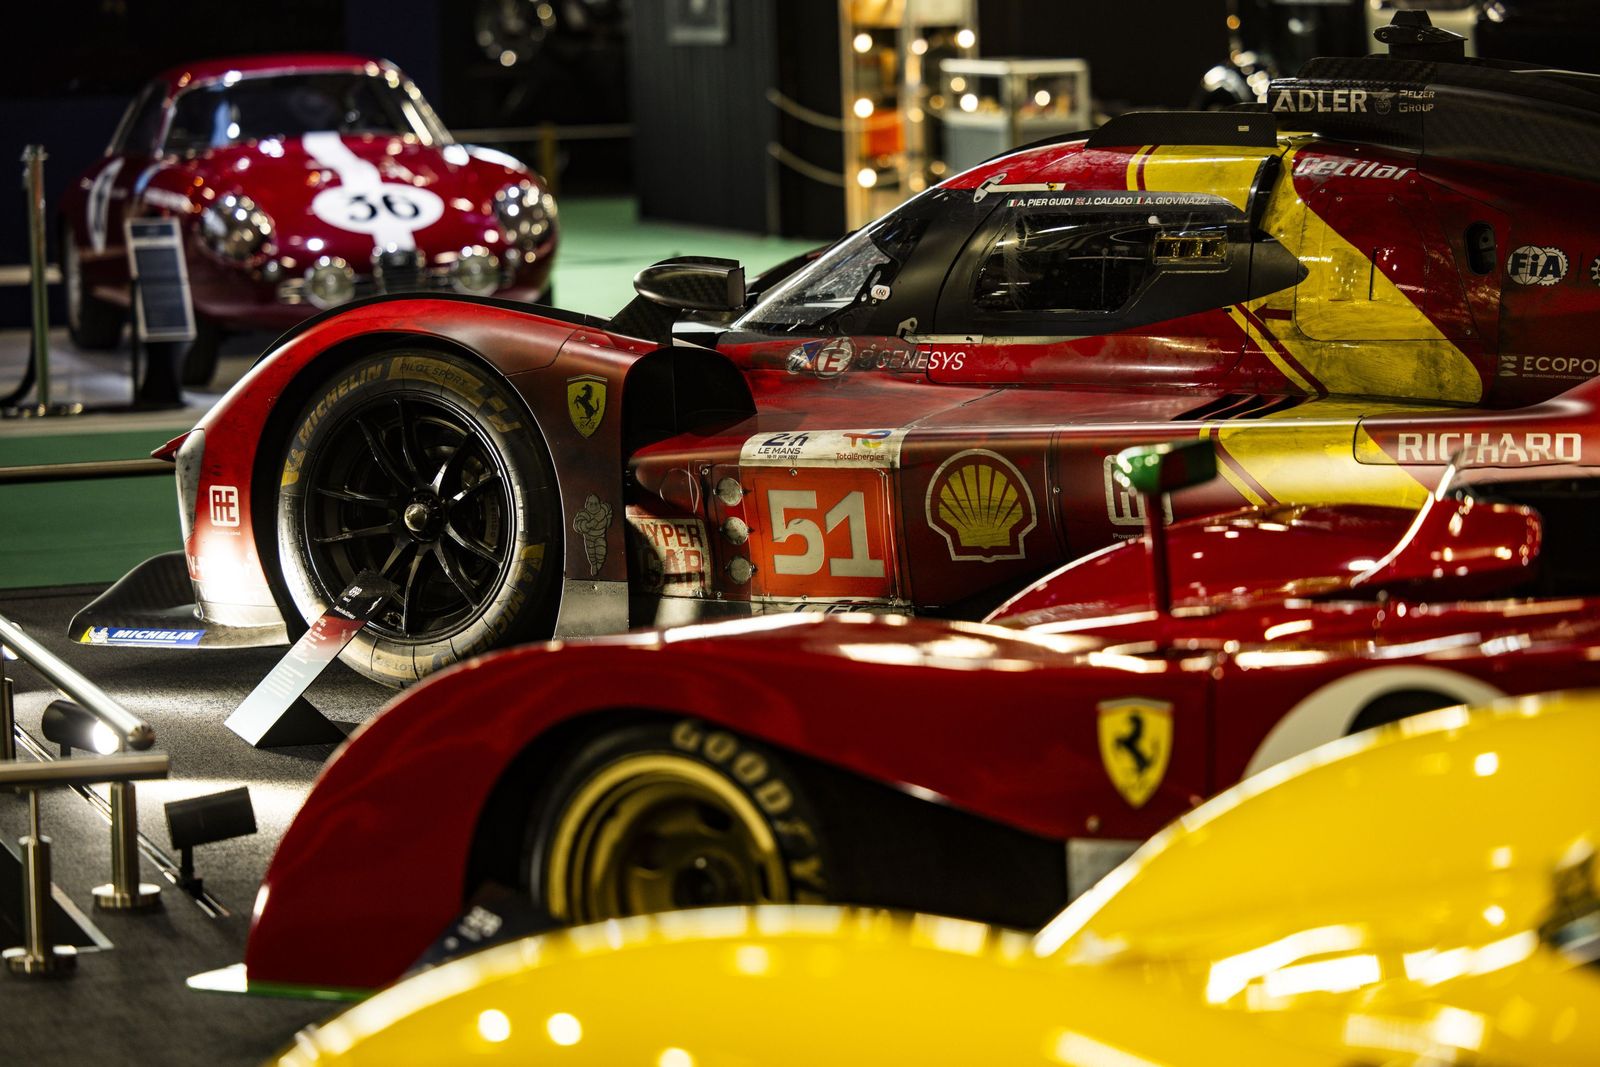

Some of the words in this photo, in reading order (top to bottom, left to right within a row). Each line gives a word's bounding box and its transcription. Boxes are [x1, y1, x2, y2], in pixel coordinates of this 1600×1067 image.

[1272, 89, 1368, 113] ADLER
[347, 194, 422, 223] 36
[1017, 198, 1027, 207] A.
[1027, 198, 1049, 207] PIER
[1049, 198, 1074, 206] GUIDI
[1085, 197, 1093, 205] J.
[1093, 197, 1134, 205] CALADO
[1144, 197, 1154, 205] A.
[1155, 196, 1211, 205] GIOVINAZZI
[876, 348, 967, 371] GENESYS
[297, 362, 385, 446] MICHELIN
[757, 447, 771, 455] LE
[771, 447, 802, 455] MANS
[835, 452, 886, 462] TotalEnergies
[1397, 432, 1582, 465] RICHARD
[767, 489, 886, 579] 51
[112, 629, 200, 641] MICHELIN
